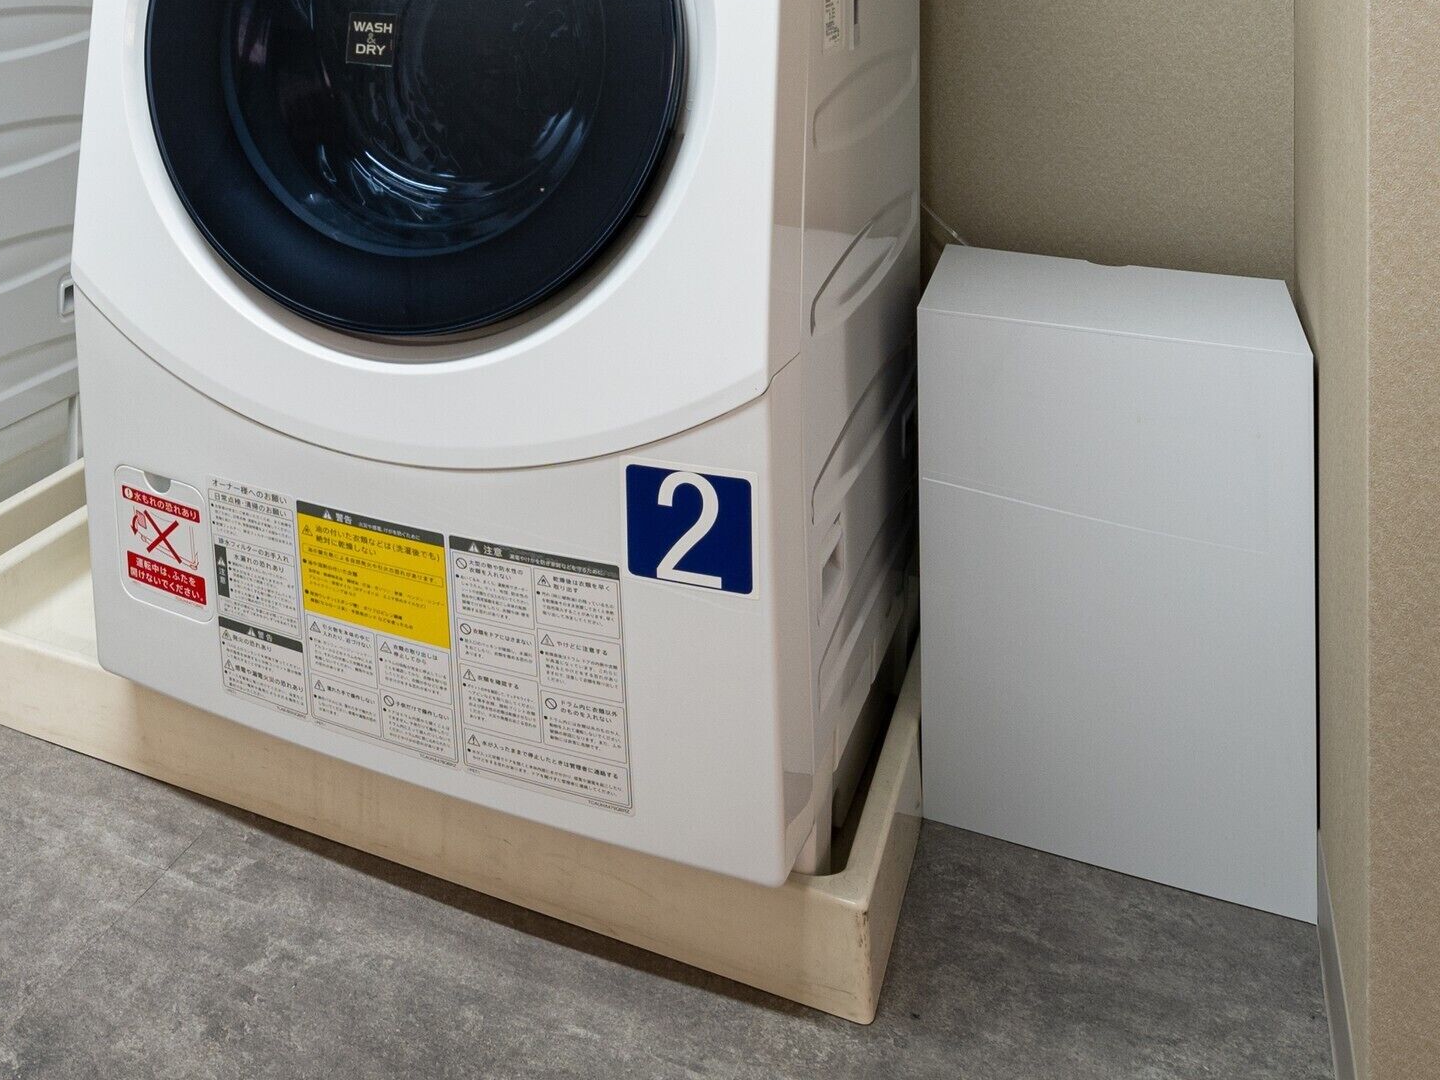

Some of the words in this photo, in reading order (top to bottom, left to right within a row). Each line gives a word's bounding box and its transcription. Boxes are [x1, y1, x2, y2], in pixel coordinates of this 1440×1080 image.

[353, 21, 392, 34] WASH
[367, 33, 376, 44] &
[356, 43, 386, 55] DRY
[211, 477, 287, 505] オーナー様へのお願い
[134, 491, 197, 520] 水もれの恐れあり
[213, 491, 287, 519] 日常点検・清掃のお願い
[335, 512, 352, 524] 警告
[656, 471, 722, 589] 2
[217, 537, 289, 563] 排水フィルターのお手入れ
[315, 535, 376, 557] 絶対に乾燥しない
[483, 545, 502, 557] 注意
[468, 567, 512, 581] 衣類を入れない
[130, 568, 204, 602] 開けないでください。
[552, 575, 610, 592] 乾燥後は衣類を早く
[552, 583, 578, 594] 取り出す
[473, 628, 532, 647] 衣類をドアにはさまない
[556, 640, 608, 656] やけどに注意する
[477, 675, 519, 690] 衣類を確認する
[395, 699, 449, 721] 子供だけで操作しない
[560, 699, 618, 718] ドラム内に衣類以外
[560, 706, 612, 724] のものを入れない
[481, 739, 618, 780] 水が入ったままで停止したときは管理者に連絡する
